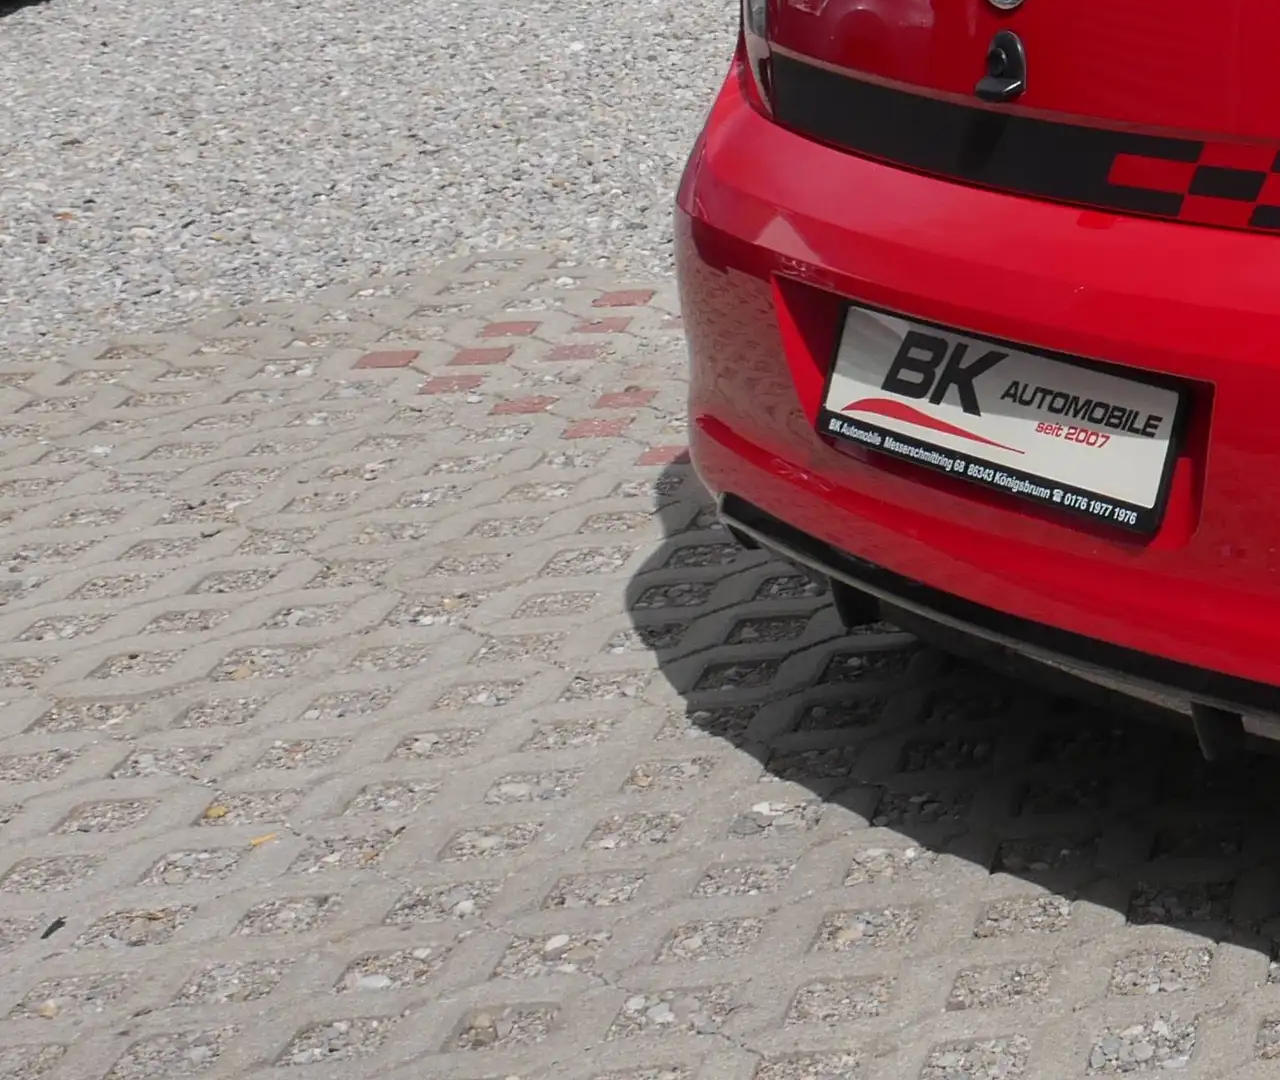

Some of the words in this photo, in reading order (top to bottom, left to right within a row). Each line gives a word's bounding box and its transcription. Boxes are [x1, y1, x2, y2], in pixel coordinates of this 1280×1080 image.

[881, 330, 1010, 417] BK
[1000, 380, 1164, 439] AUTOMOBILE
[1035, 421, 1063, 438] seit
[1064, 426, 1111, 449] 2007
[828, 418, 842, 433] BK
[841, 422, 882, 446] Automobile
[883, 436, 953, 471] Messerschmittring
[953, 459, 965, 473] 68
[967, 464, 994, 482] 86343
[994, 470, 1051, 499] Königsbrunn
[1063, 492, 1087, 511] 0176
[1089, 500, 1112, 517] 1977
[1113, 507, 1138, 525] 1976
